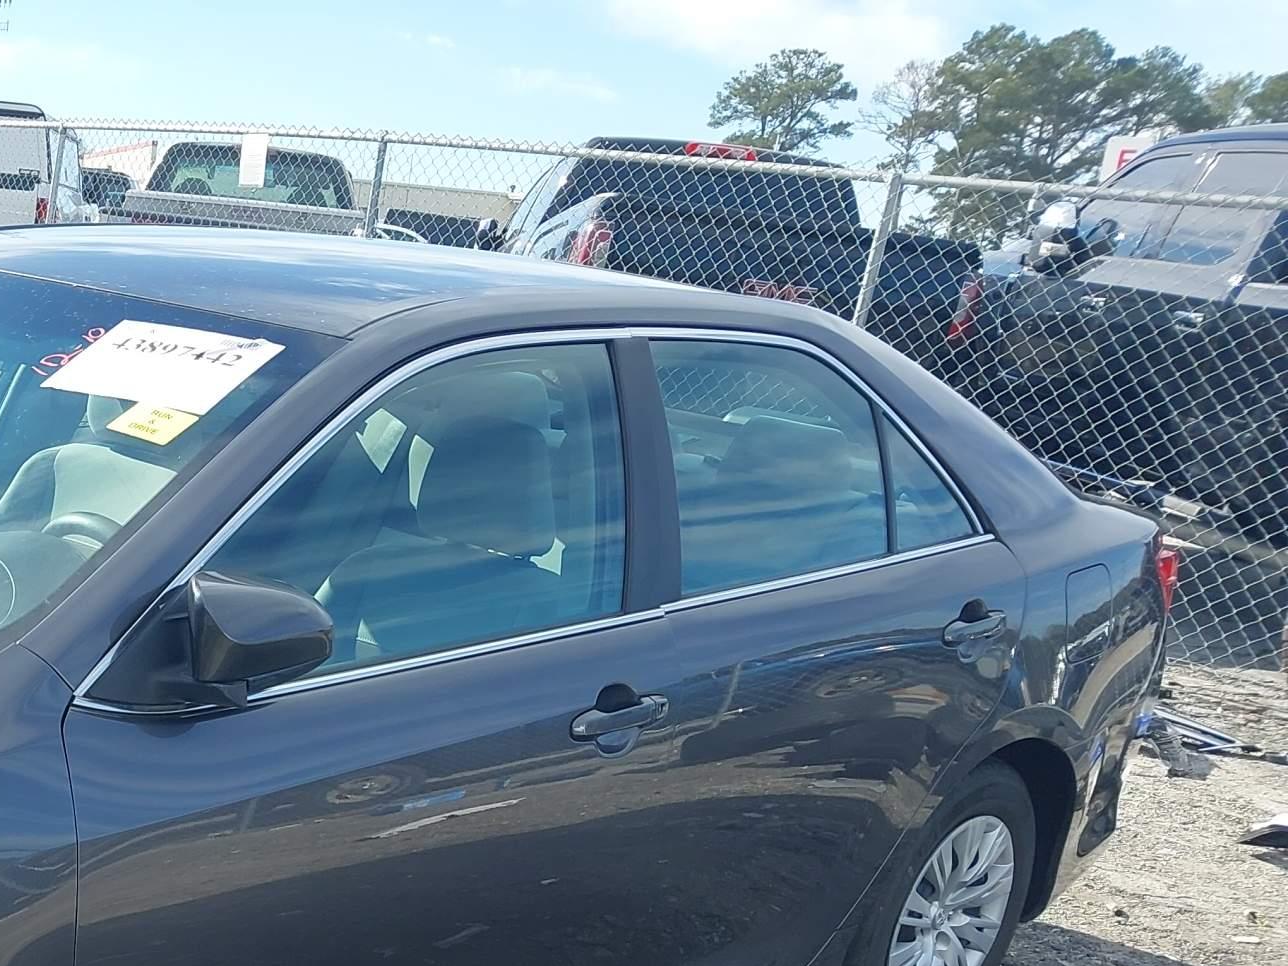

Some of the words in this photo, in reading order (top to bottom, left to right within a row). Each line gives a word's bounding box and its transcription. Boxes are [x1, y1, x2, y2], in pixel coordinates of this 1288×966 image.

[112, 337, 243, 367] 43897442
[150, 408, 174, 420] RUN
[128, 421, 160, 435] DRIVE
